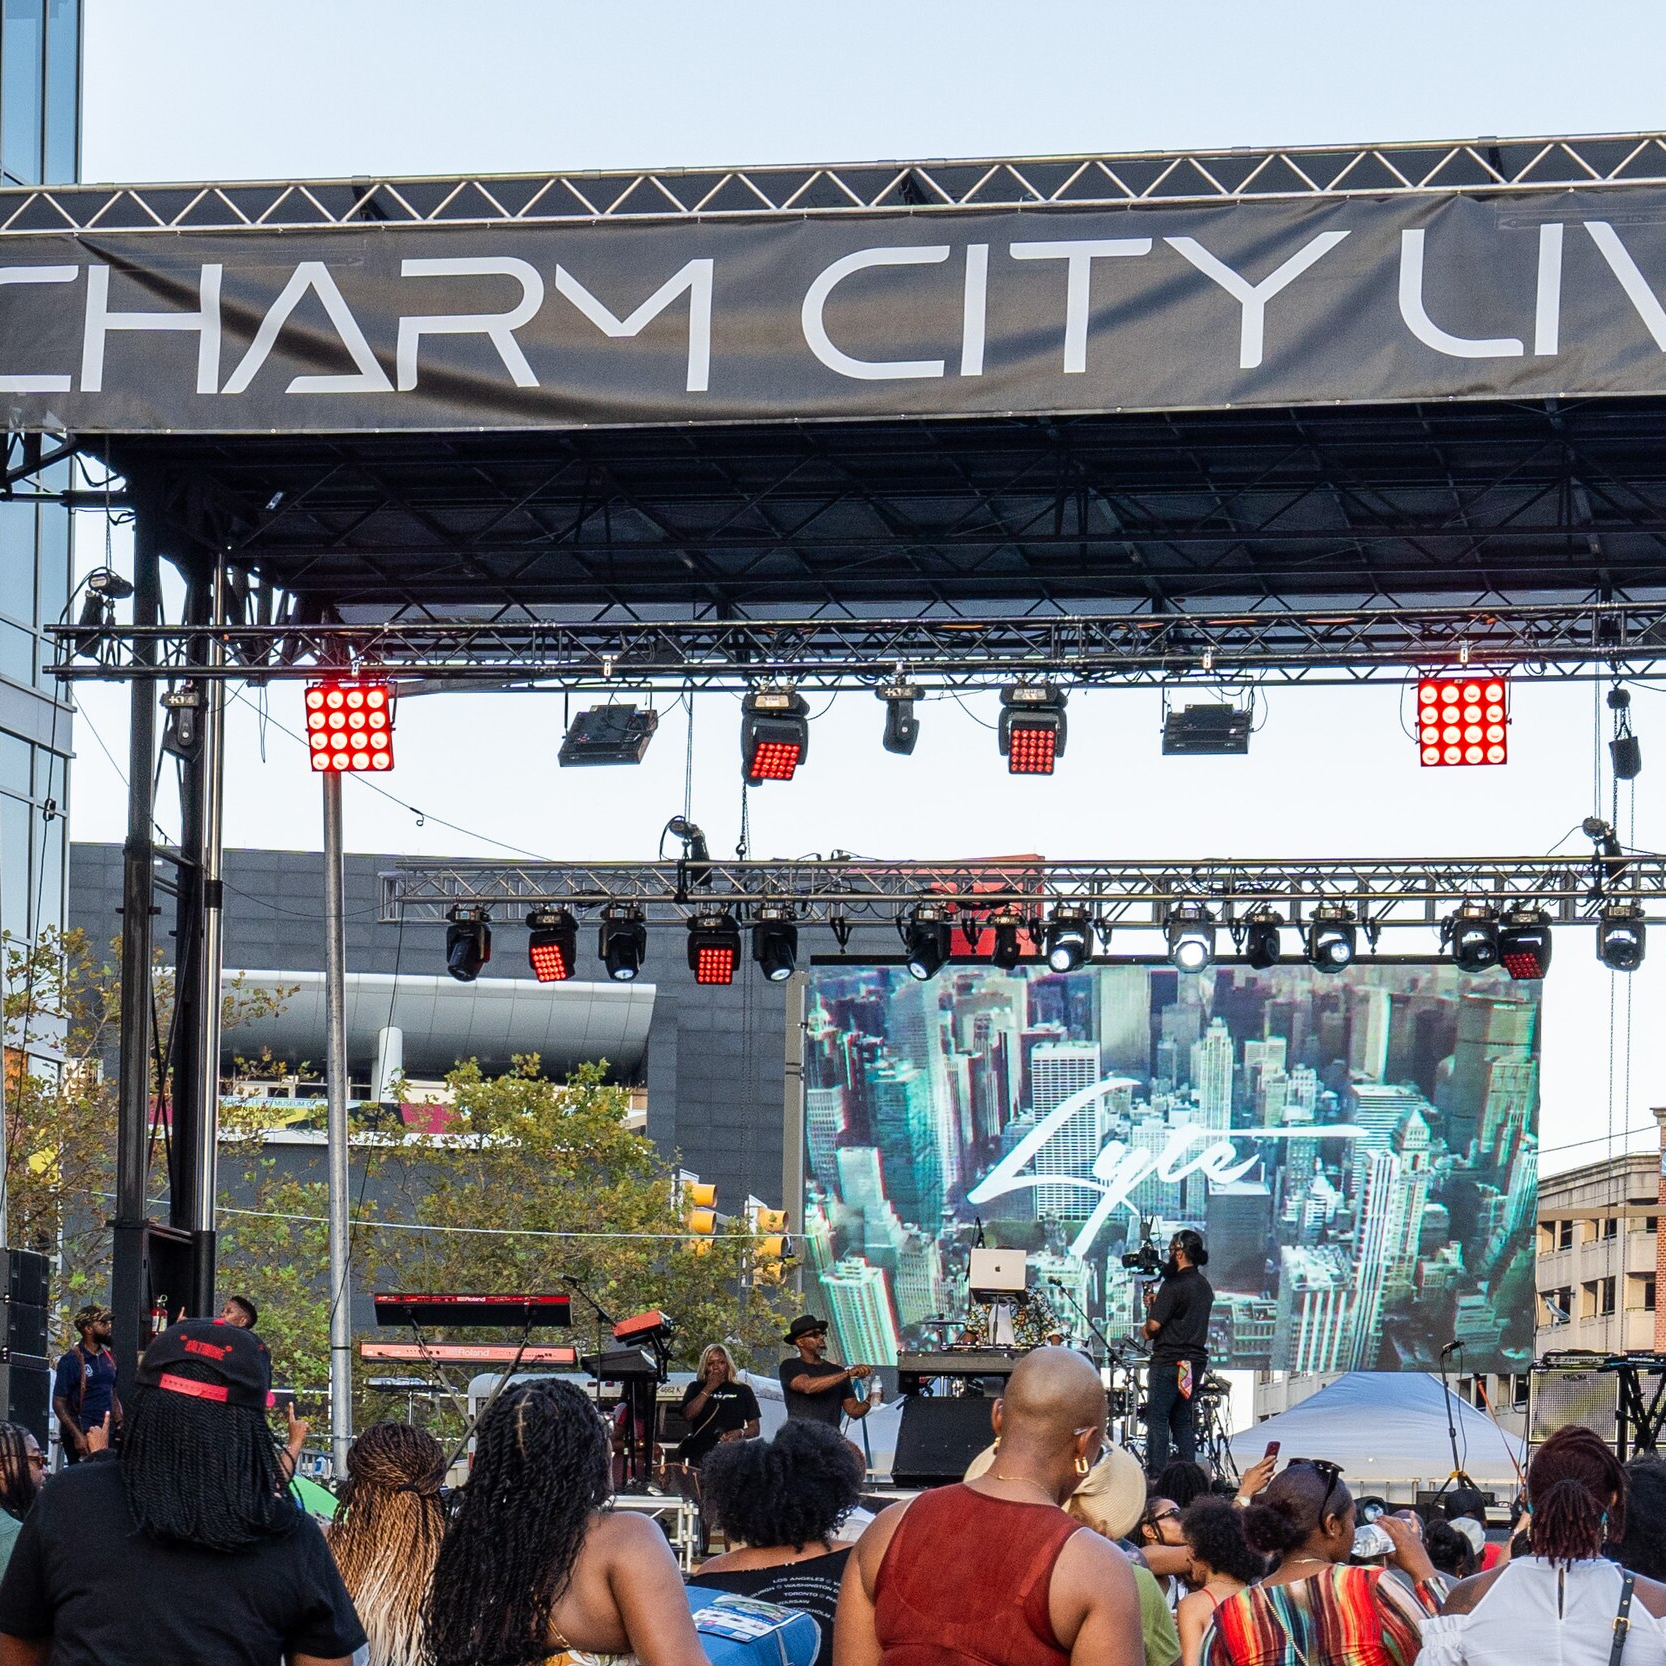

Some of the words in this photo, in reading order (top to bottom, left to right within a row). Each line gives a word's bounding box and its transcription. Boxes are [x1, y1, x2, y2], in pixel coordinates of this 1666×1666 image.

[800, 229, 1351, 380] CITY
[968, 1076, 1368, 1258] Lyte
[458, 1348, 491, 1357] Roland
[783, 1583, 832, 1592] WASHINGTON
